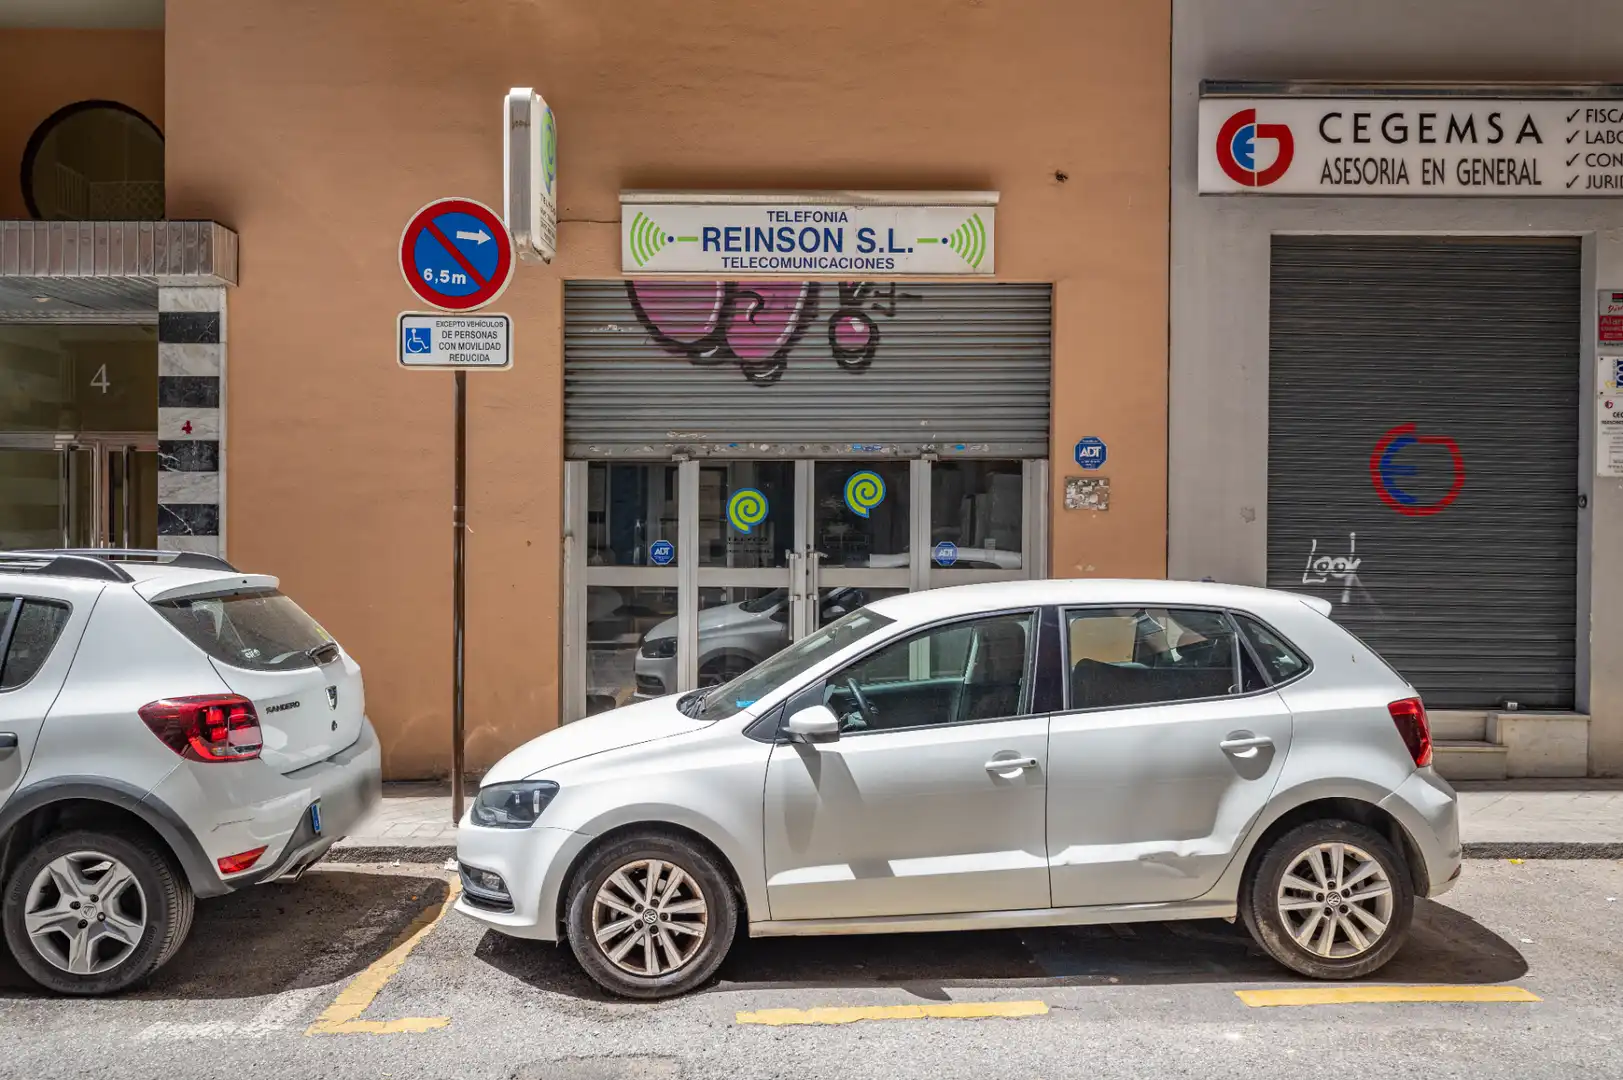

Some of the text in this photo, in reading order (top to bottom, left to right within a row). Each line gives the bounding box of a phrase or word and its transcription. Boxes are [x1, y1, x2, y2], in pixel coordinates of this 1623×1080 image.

[1319, 112, 1543, 144] CEGEMSA
[1320, 157, 1542, 186] ASESORIA EN GENERAL
[1585, 174, 1623, 189] JURI
[766, 210, 848, 223] TELEFONIA
[702, 226, 914, 254] REINSON S.L.
[721, 256, 895, 270] TELECOMUNICACIONES
[423, 268, 467, 285] 6,5m
[436, 319, 504, 328] EXCEPTO VEHÍCULOS
[441, 330, 498, 340] DE PERSONAS
[438, 341, 502, 351] CON MOVILIDAD
[449, 353, 490, 362] REDUCIDA
[90, 363, 111, 394] 4
[1079, 446, 1102, 458] ADT
[654, 547, 671, 556] ADT
[937, 548, 954, 557] ADT
